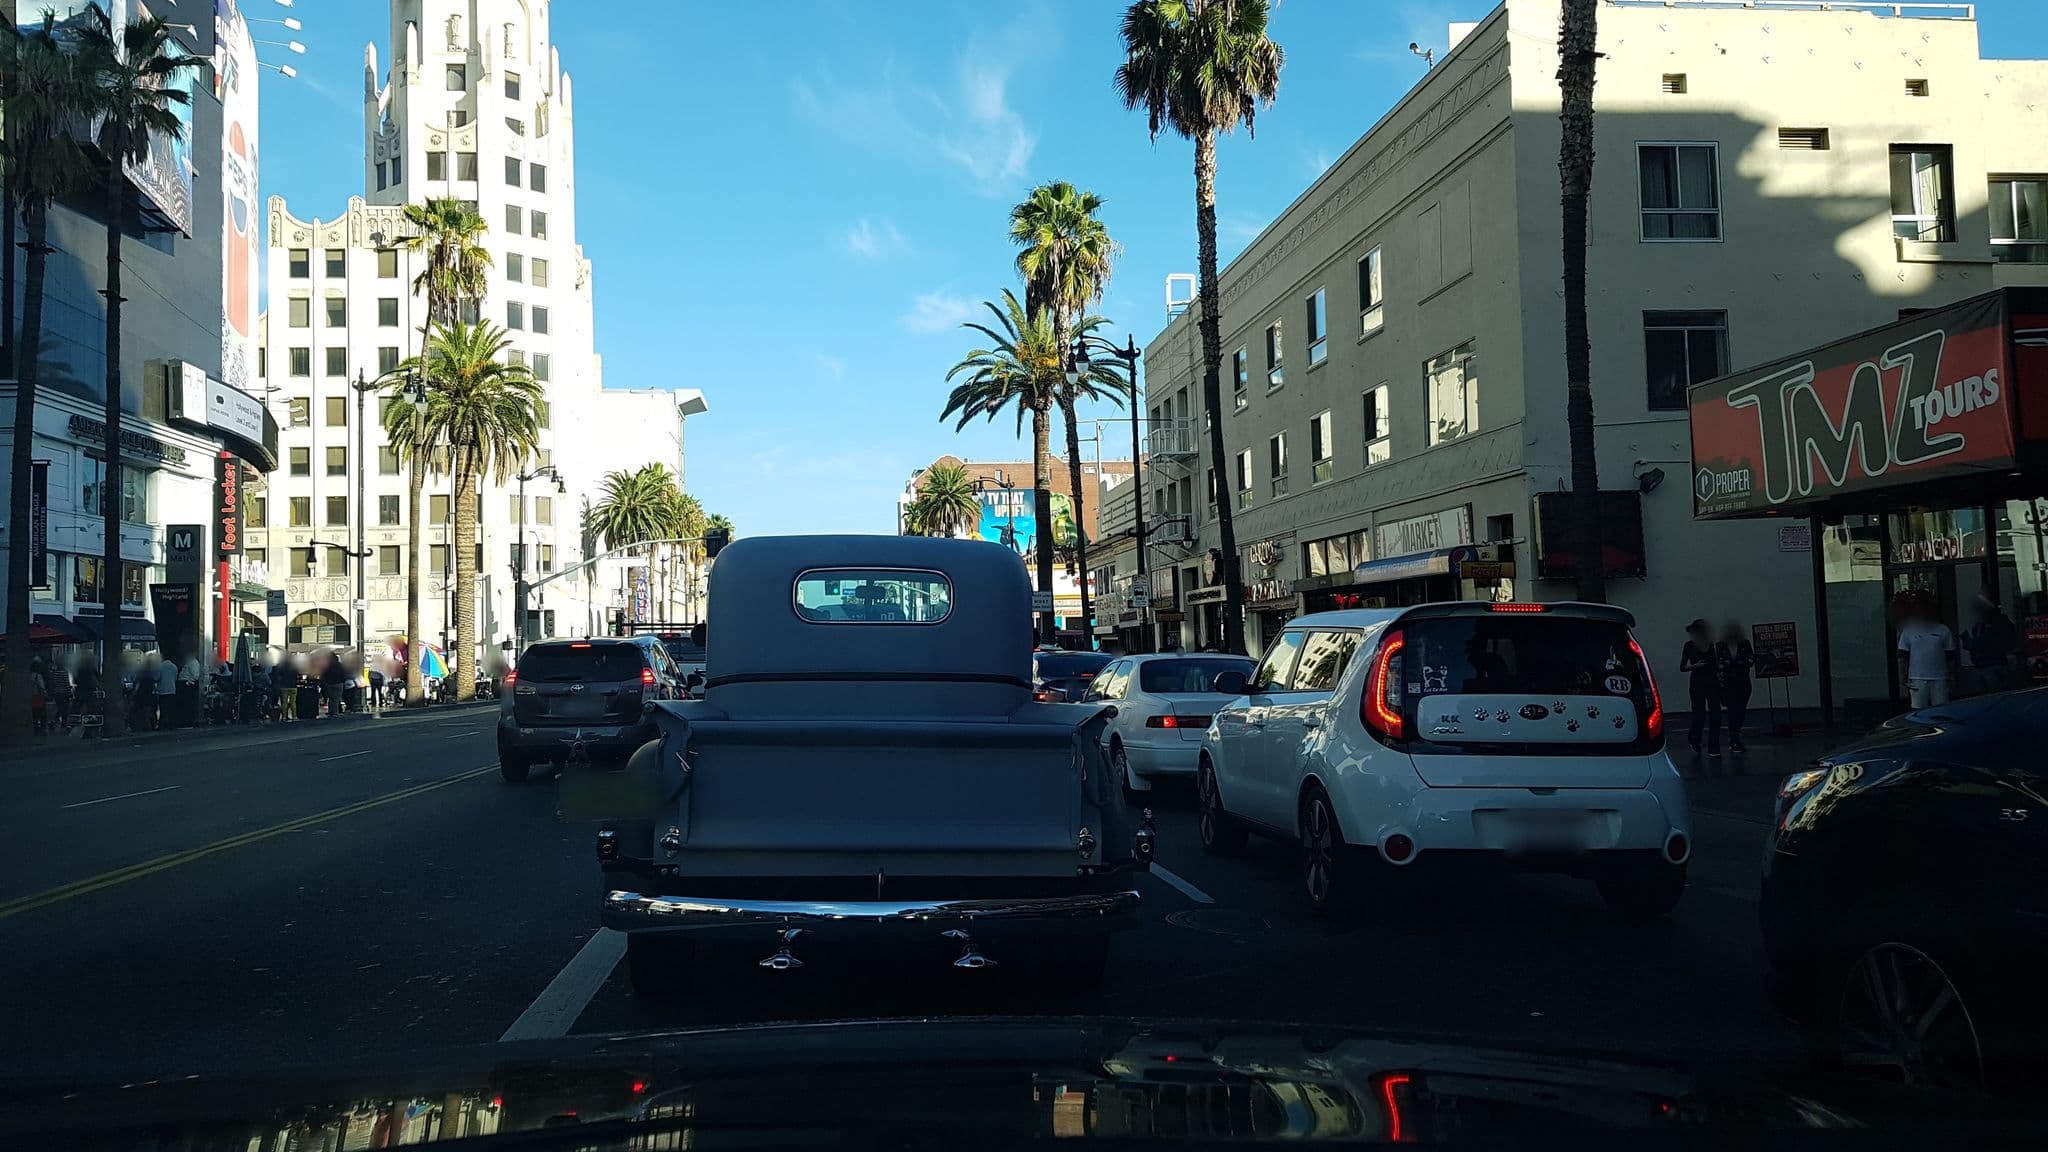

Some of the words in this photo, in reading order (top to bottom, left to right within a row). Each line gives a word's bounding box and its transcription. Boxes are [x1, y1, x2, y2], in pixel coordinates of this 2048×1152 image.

[1727, 329, 1964, 504] TMZ
[1910, 368, 2000, 430] TOURS
[221, 463, 235, 510] Locker
[987, 492, 999, 505] TV
[1000, 491, 1025, 504] THAT
[1715, 468, 1750, 495] PROPER
[175, 533, 191, 548] M
[221, 511, 236, 550] Foot
[1402, 517, 1440, 552] MARKET
[637, 584, 645, 622] MUSEU
[1609, 678, 1629, 691] RB
